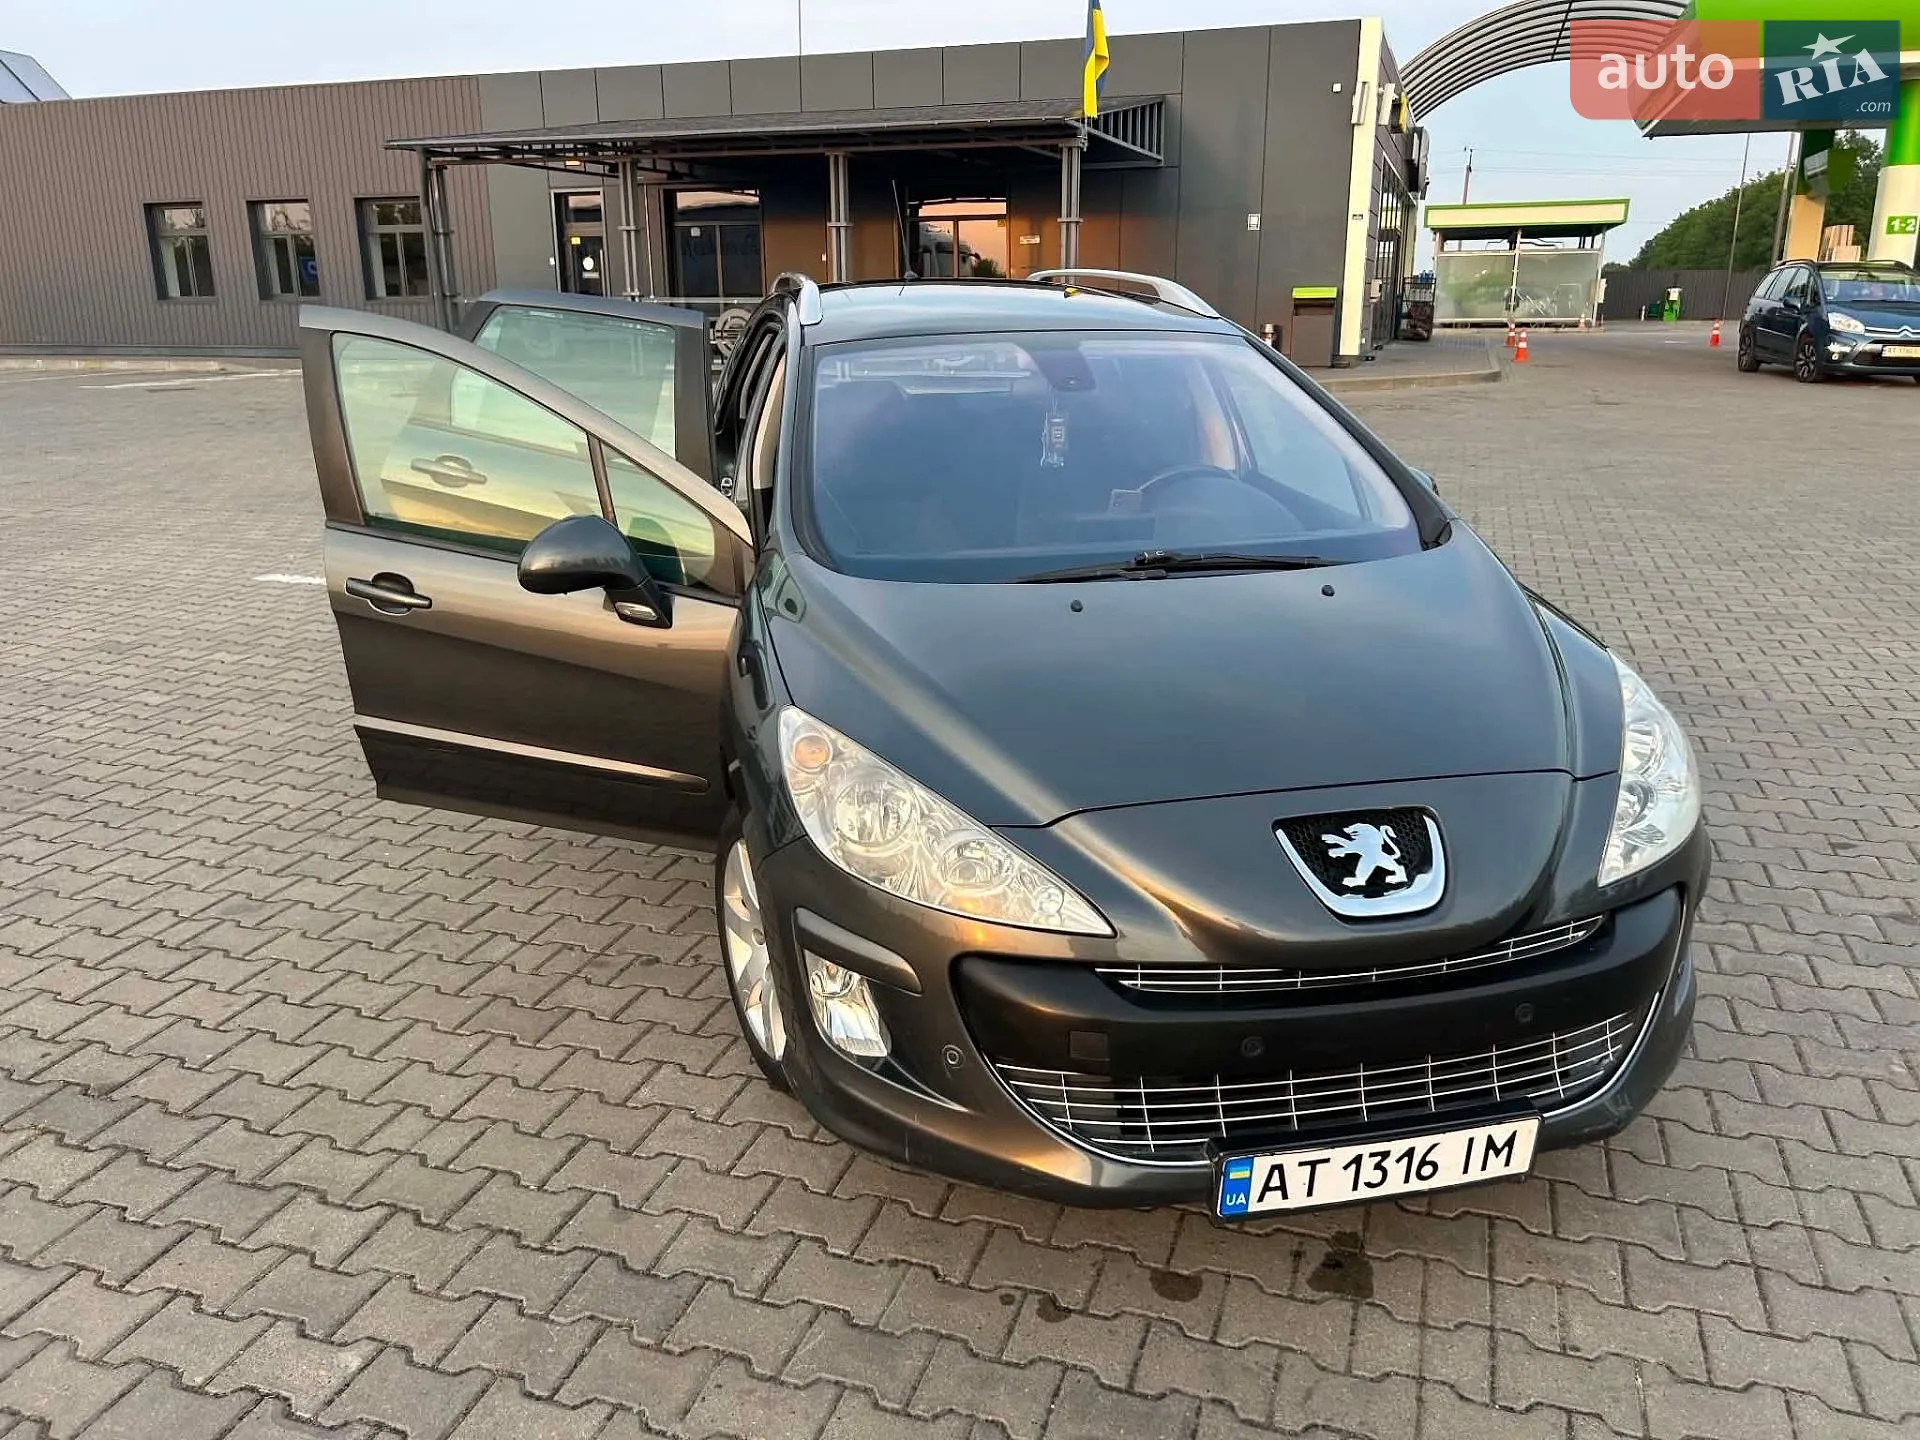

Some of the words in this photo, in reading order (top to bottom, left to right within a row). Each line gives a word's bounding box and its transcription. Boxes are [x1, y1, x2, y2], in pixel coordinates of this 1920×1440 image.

[1890, 218, 1916, 232] 1-2
[1256, 1157, 1331, 1203] AT
[1342, 1142, 1441, 1192] 1316
[1462, 1130, 1518, 1175] IM
[1226, 1192, 1247, 1206] UA
